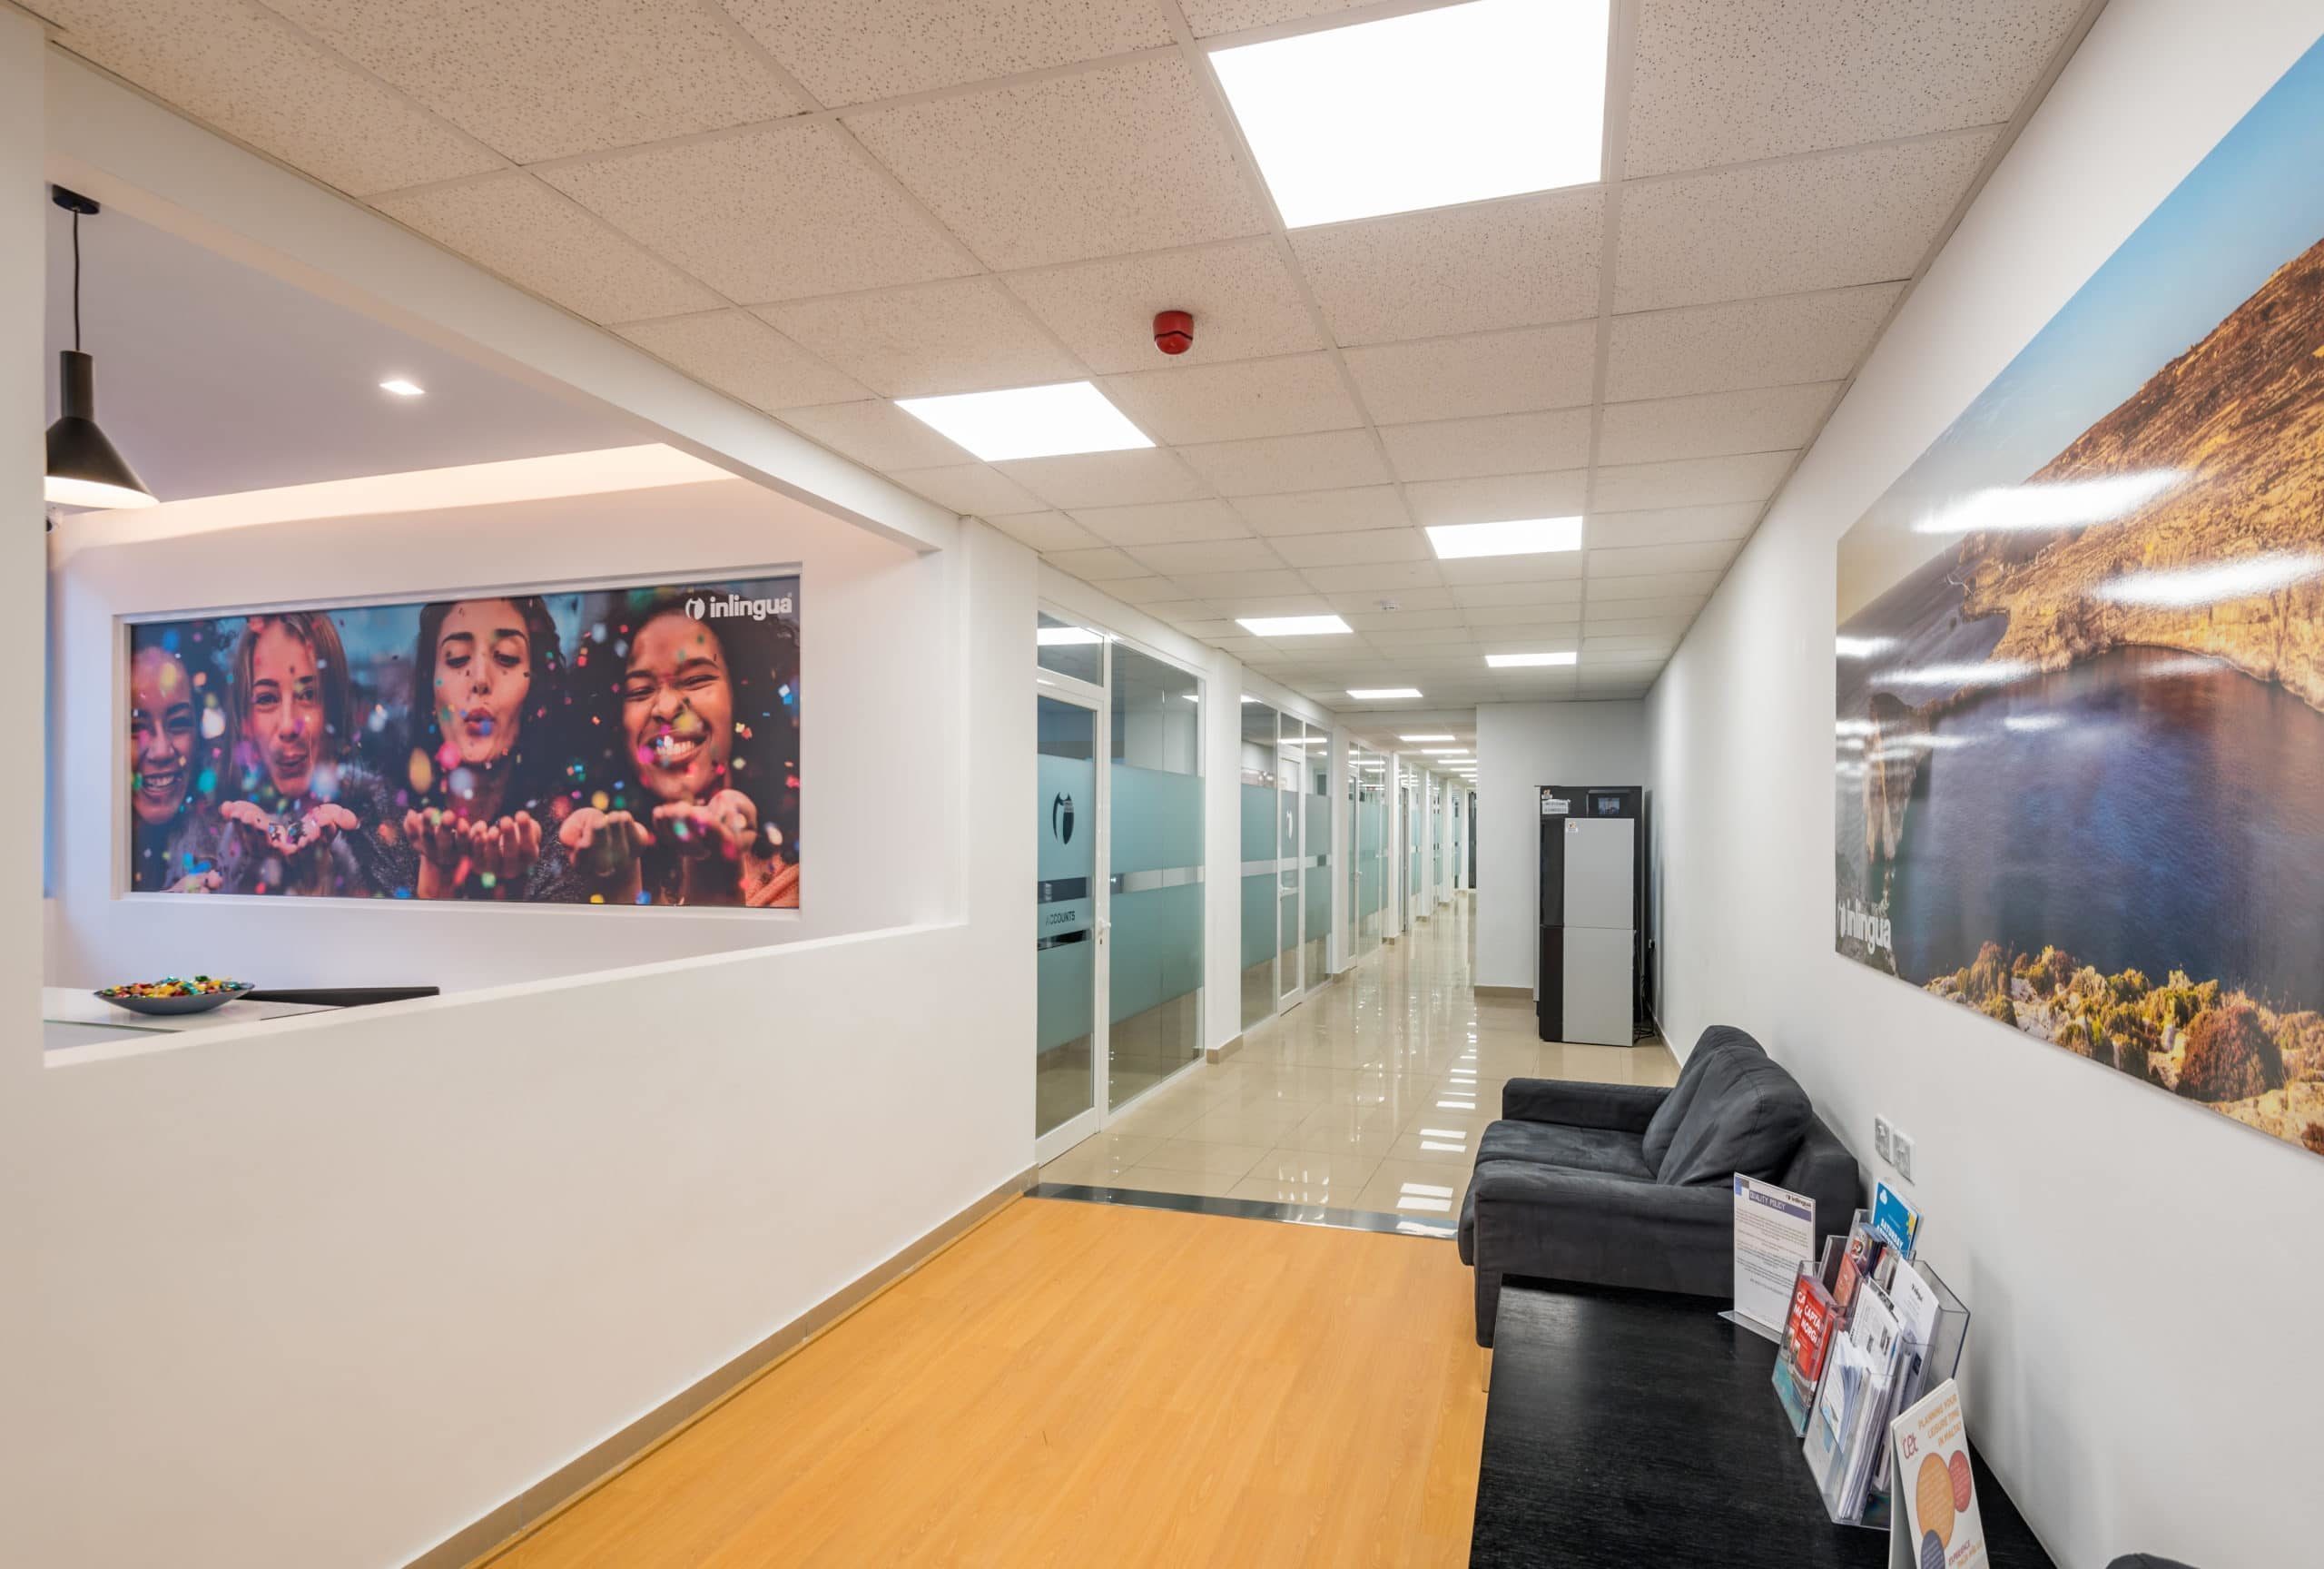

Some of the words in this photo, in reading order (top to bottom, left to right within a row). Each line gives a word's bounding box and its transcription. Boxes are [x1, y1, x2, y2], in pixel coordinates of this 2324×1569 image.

[710, 594, 793, 621] inlingua
[1045, 911, 1075, 926] ACCOUNTS
[1846, 898, 1892, 954] inlingua
[1749, 1191, 1768, 1206] QUALITY
[1769, 1198, 1787, 1210] POLICY
[1804, 1305, 1822, 1330] CAPTA
